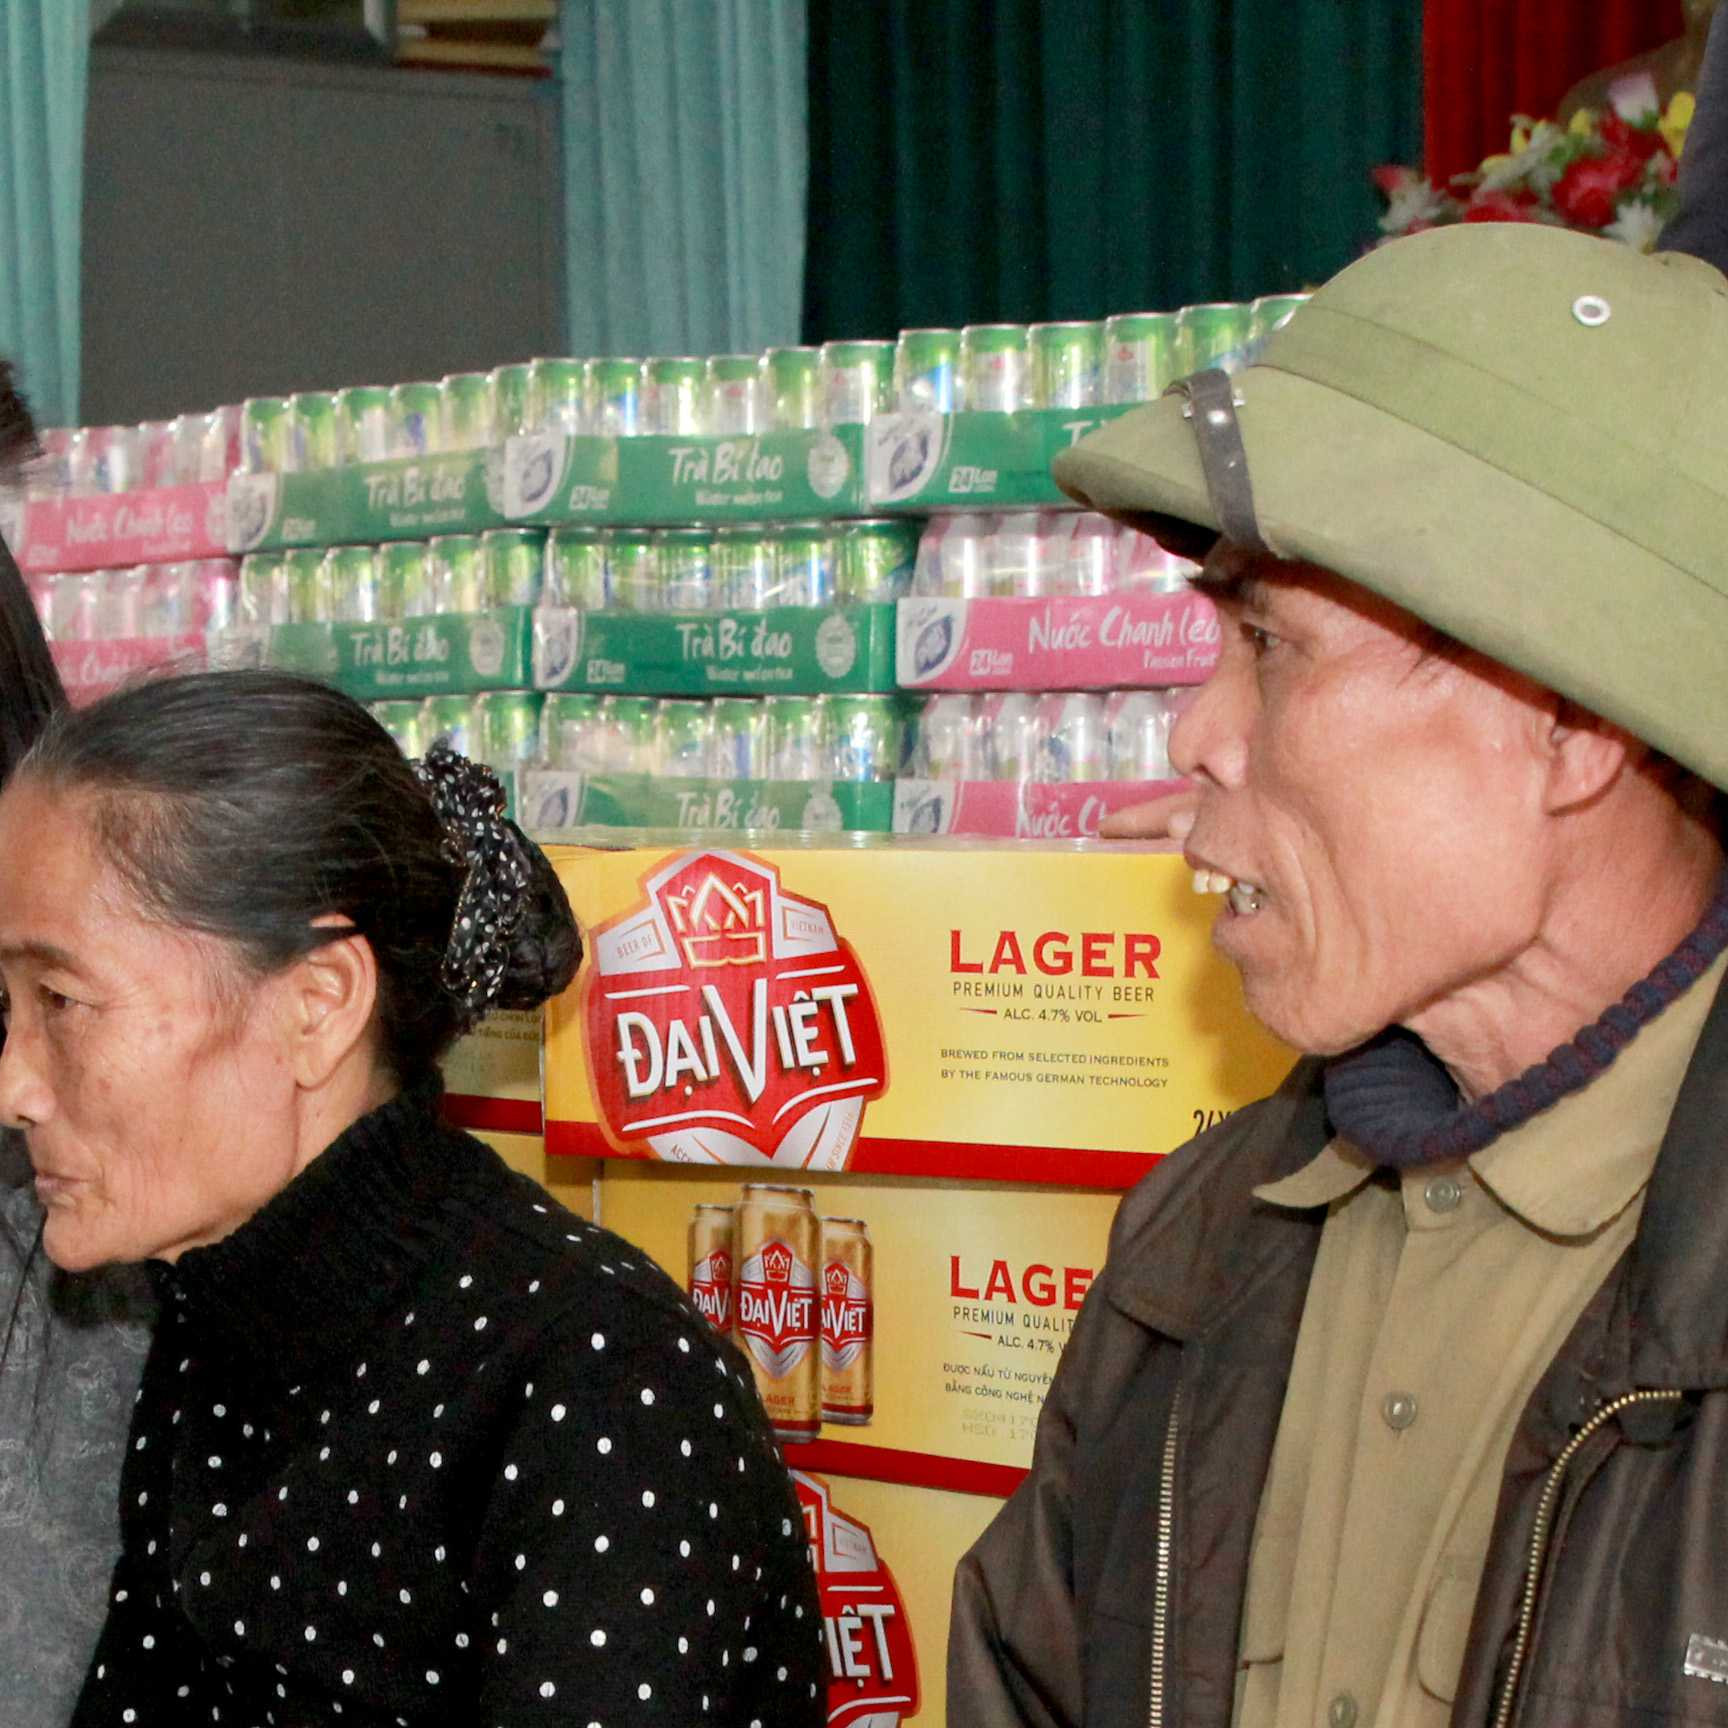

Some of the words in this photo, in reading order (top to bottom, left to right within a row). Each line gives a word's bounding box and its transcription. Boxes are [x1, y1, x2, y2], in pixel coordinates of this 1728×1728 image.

[676, 618, 715, 659] Trà
[717, 618, 747, 658] Bí
[751, 615, 792, 657] đao
[1028, 607, 1091, 653] Nước
[1099, 607, 1174, 649] Chanh
[950, 930, 1161, 979] LAGER
[953, 981, 1023, 997] PREMIUM
[1033, 983, 1103, 1001] QUALITY
[1113, 986, 1154, 1002] BEER
[1004, 1008, 1034, 1021] ALC.
[1038, 1010, 1070, 1023] 4.7%
[1076, 1011, 1103, 1023] VOL
[941, 1049, 988, 1060] BREWED
[992, 1050, 1024, 1062] FROM
[1028, 1051, 1087, 1064] SELECTED
[1089, 1054, 1169, 1067] INGREDIENTS
[941, 1069, 955, 1079] BY
[959, 1070, 982, 1081] THE
[985, 1071, 1033, 1083] FAMOUS
[1036, 1073, 1085, 1085] GERMAN
[1089, 1075, 1168, 1088] TECHNOLOGY
[950, 1255, 1093, 1310] LAGE
[953, 1306, 1015, 1326] PREMIUM
[1023, 1313, 1074, 1332] QUALIT
[997, 1336, 1024, 1349] ALC.
[1026, 1338, 1055, 1353] 4.7%
